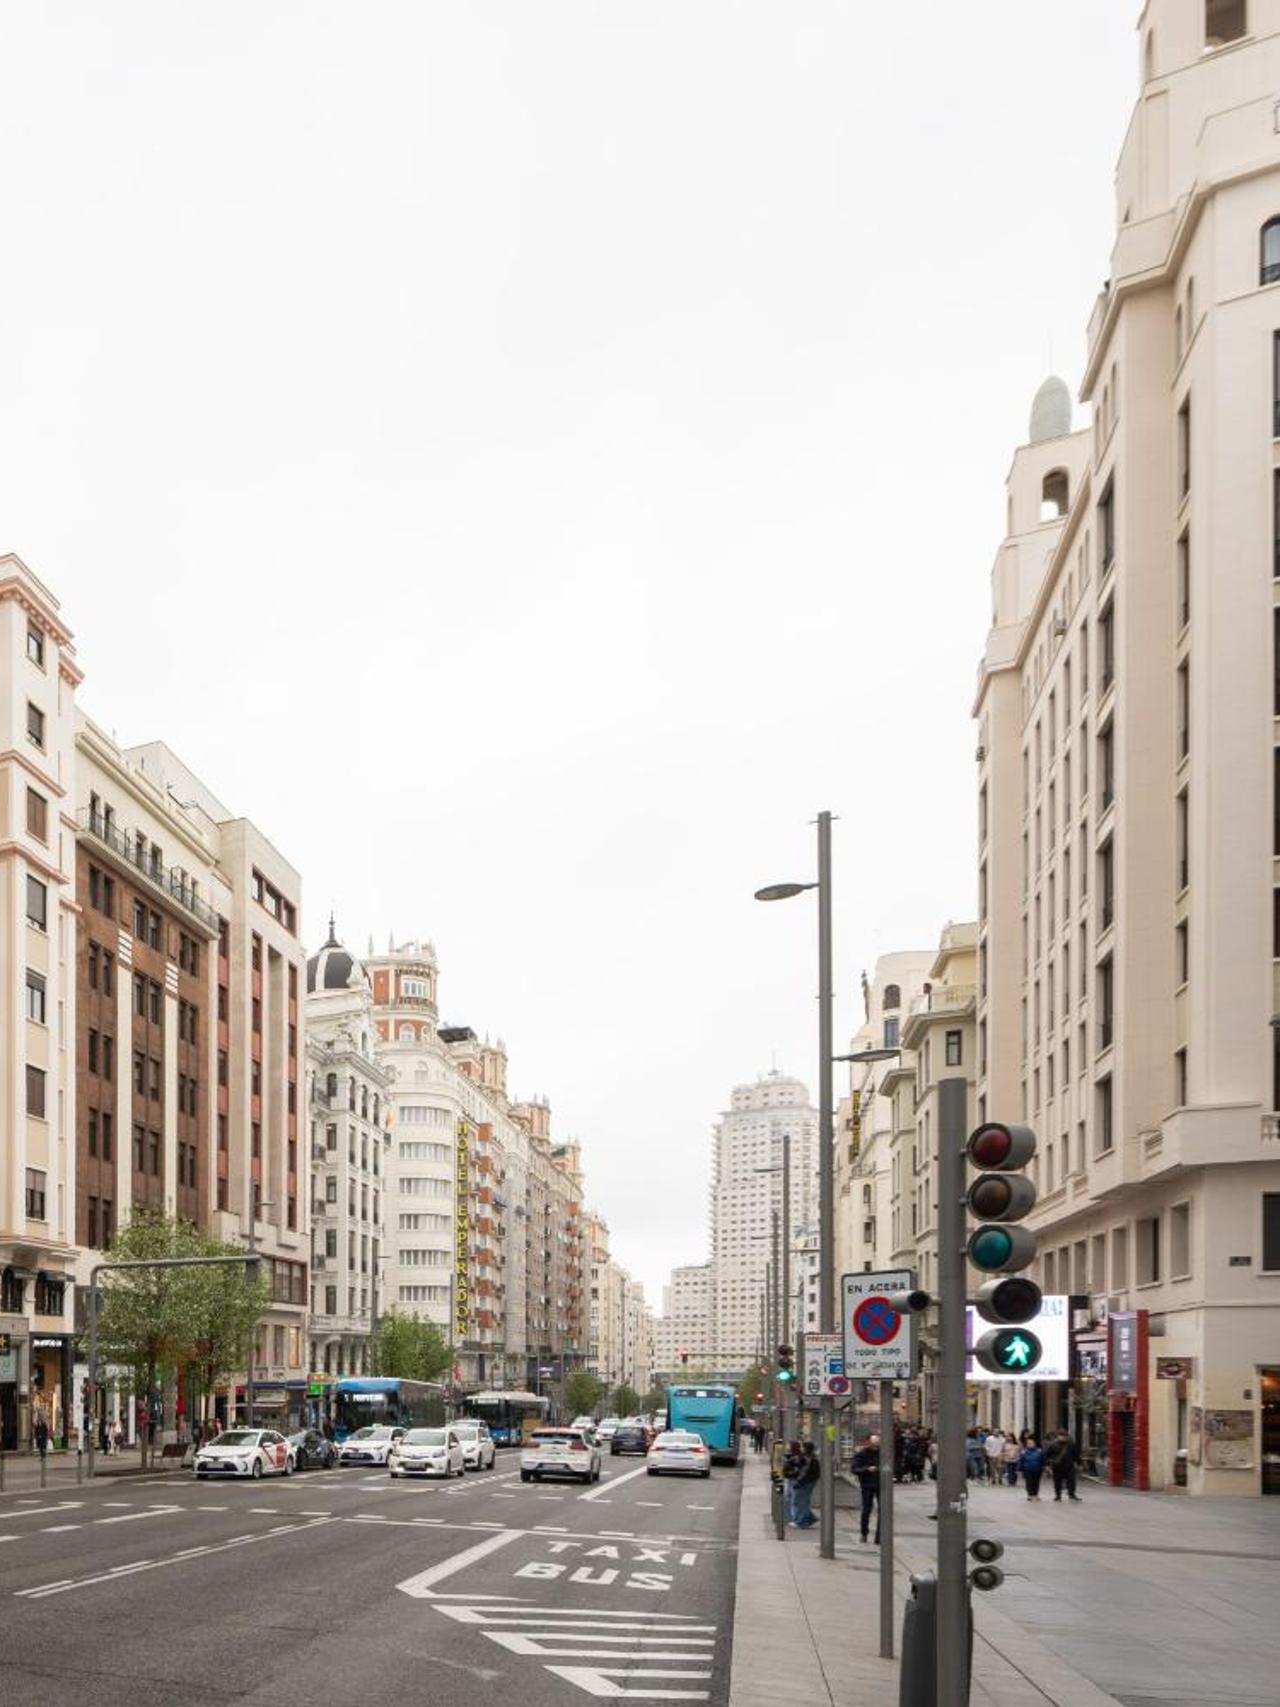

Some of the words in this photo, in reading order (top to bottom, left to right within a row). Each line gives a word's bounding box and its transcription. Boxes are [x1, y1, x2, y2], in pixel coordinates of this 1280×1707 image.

[457, 1122, 468, 1195] HOTEL
[457, 1206, 468, 1335] EMPERADOR
[847, 1284, 863, 1295] EN
[868, 1281, 906, 1293] ACERA
[854, 1349, 878, 1357] TODO
[881, 1347, 902, 1356] TIPO
[546, 1540, 698, 1567] TAXI
[512, 1561, 674, 1591] BUS
